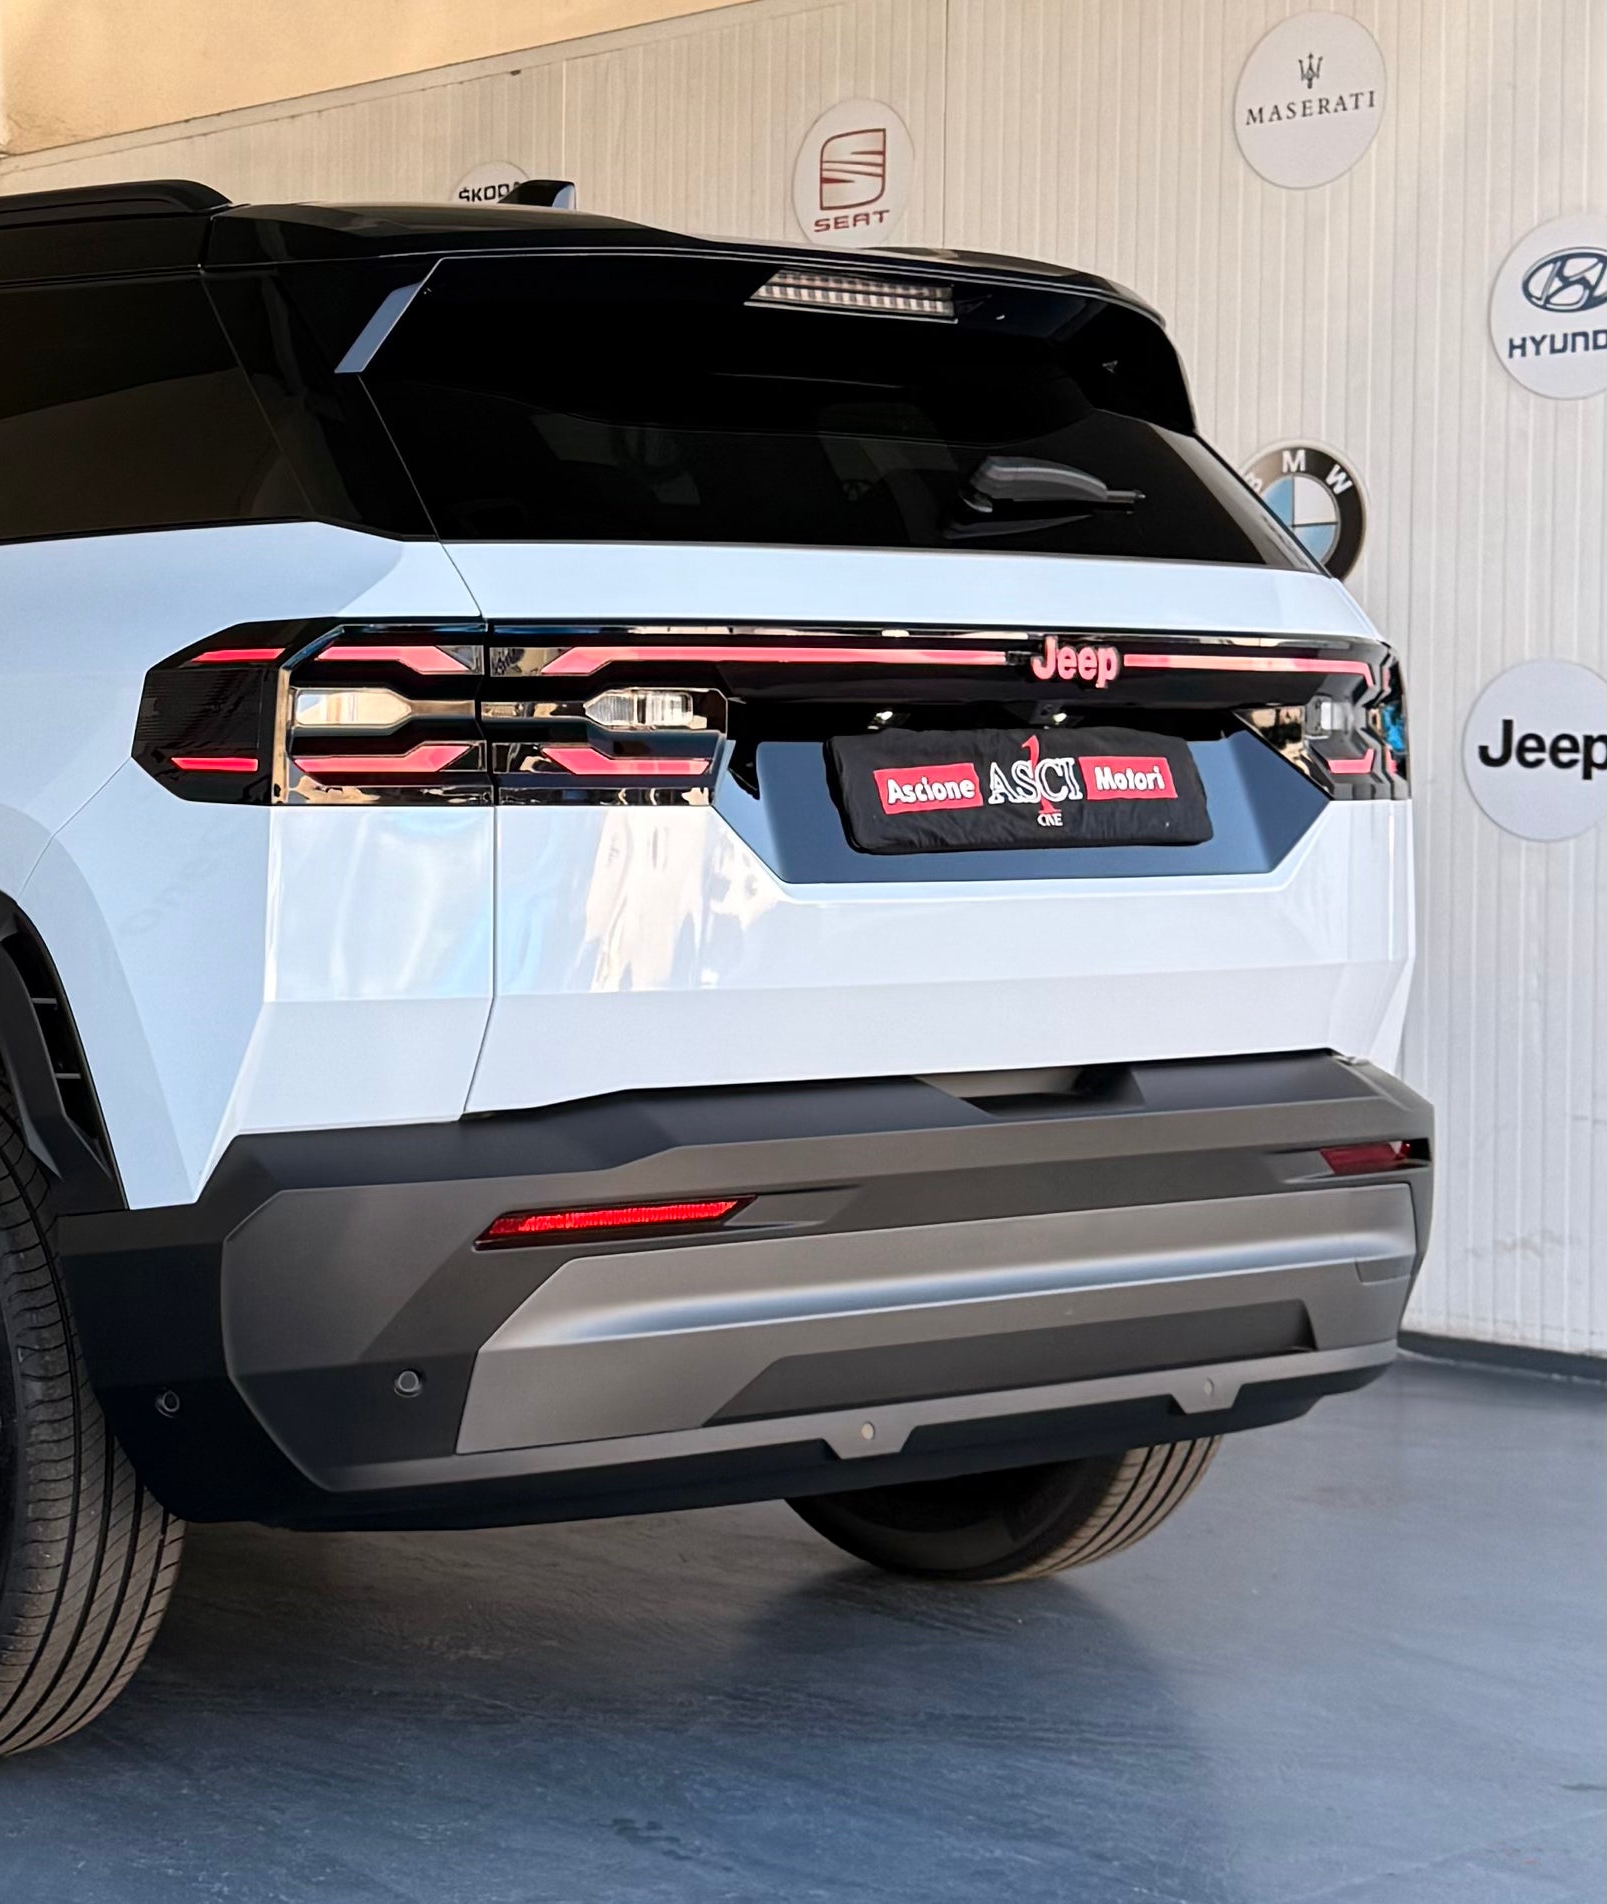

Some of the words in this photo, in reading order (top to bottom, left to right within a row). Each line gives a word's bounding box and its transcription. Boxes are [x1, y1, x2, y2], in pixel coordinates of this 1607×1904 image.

[1245, 90, 1375, 126] MASERATI
[814, 210, 890, 232] SEAT
[1031, 635, 1120, 689] Jeep
[1478, 718, 1607, 781] Jeep
[887, 776, 976, 805] Ascione
[988, 757, 1084, 805] ASCI
[1094, 764, 1166, 793] Motori
